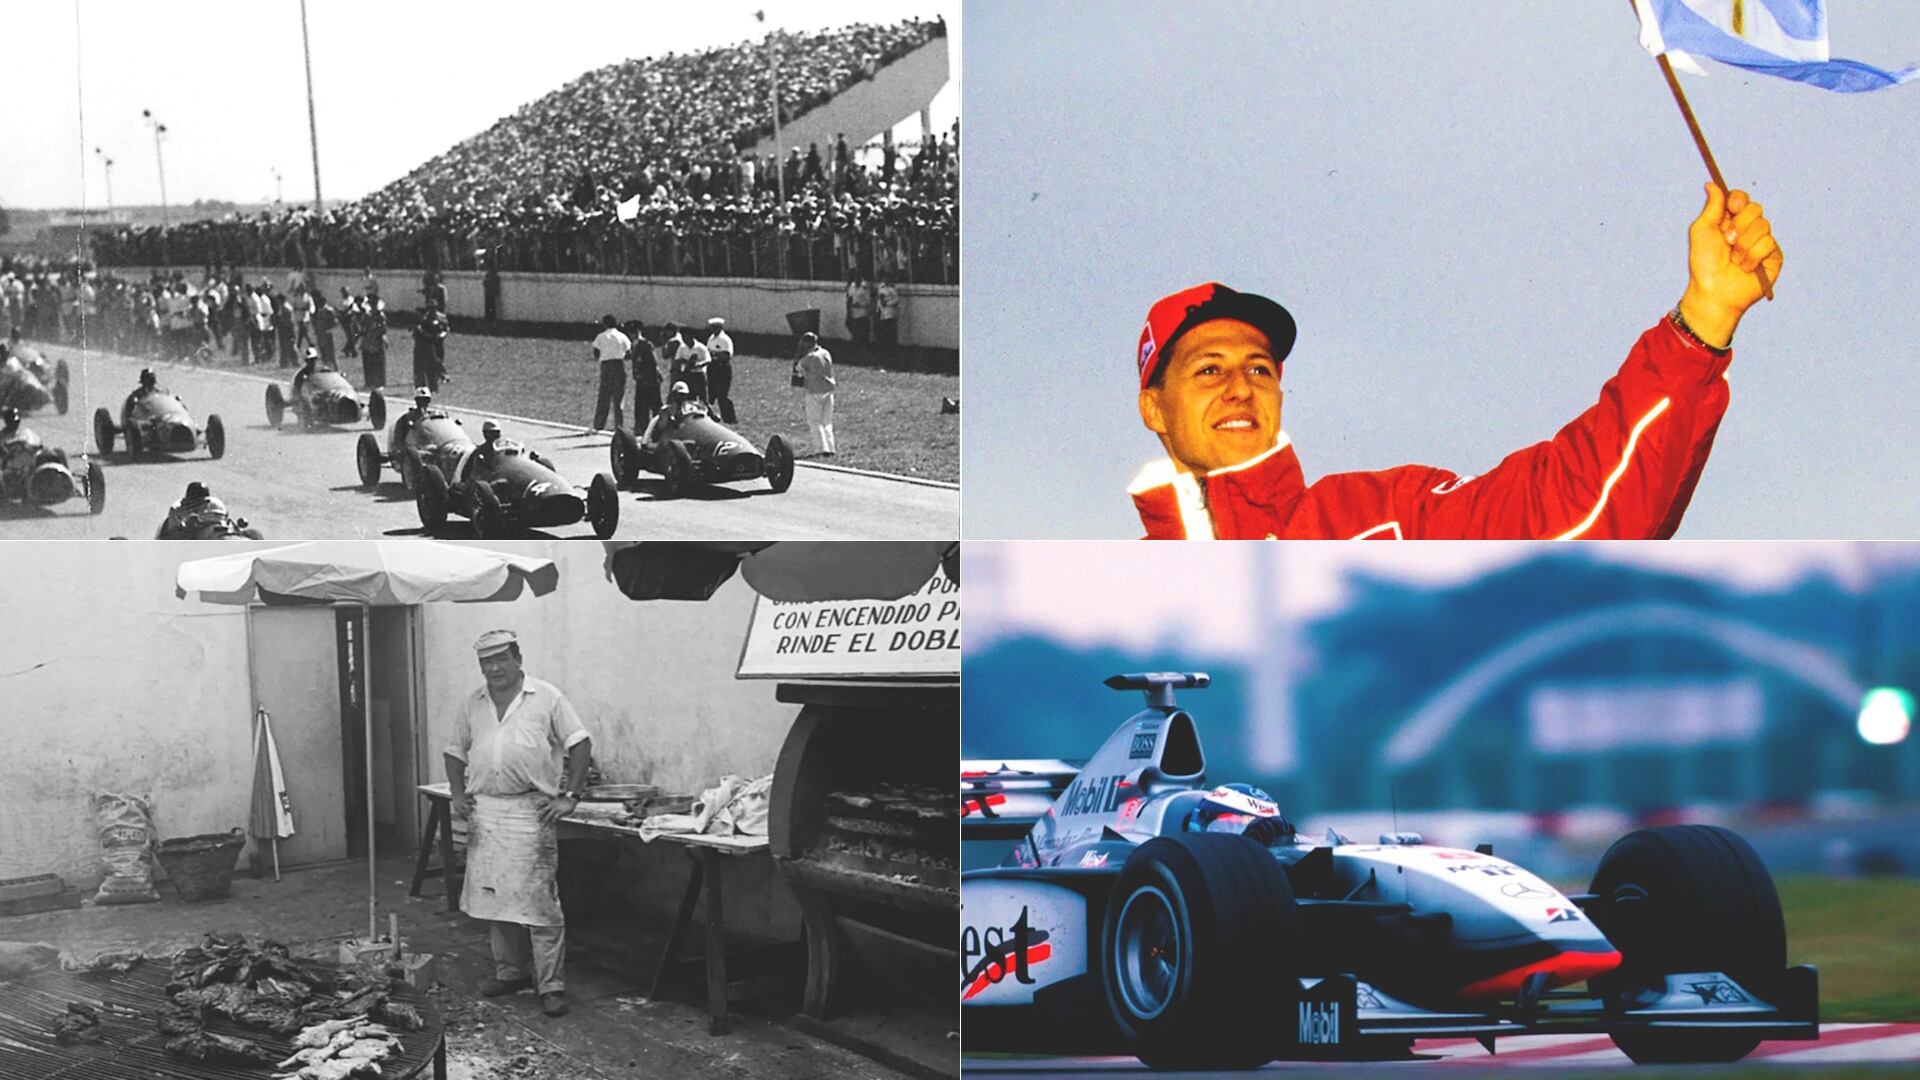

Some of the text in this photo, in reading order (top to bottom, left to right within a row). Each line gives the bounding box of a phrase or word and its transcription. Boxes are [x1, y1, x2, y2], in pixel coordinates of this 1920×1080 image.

[773, 611, 811, 630] CON
[815, 602, 931, 628] ENCENDIDO
[776, 629, 960, 654] RINDE EL DOBL
[1061, 776, 1108, 816] Mobil
[961, 905, 1036, 984] est
[1299, 1001, 1339, 1044] Mobil
